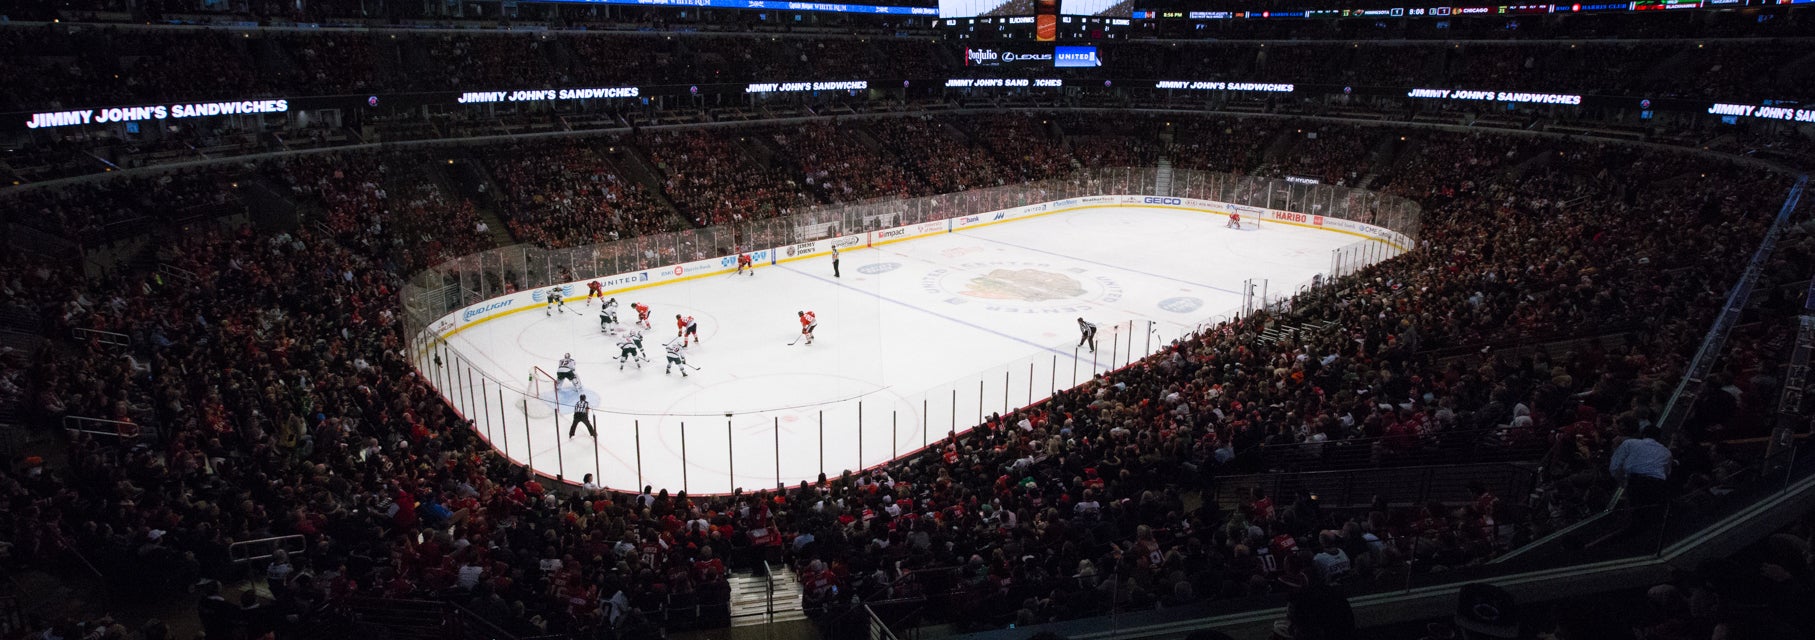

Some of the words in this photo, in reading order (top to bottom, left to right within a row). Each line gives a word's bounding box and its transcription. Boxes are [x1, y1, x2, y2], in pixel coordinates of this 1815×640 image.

[745, 83, 779, 93] JIMMY
[779, 82, 811, 92] JOHN'S
[812, 81, 867, 91] SANDWICHES
[945, 79, 973, 87] JIMMY
[974, 79, 1003, 87] JOHN'S
[1156, 80, 1189, 89] JIMMY
[1190, 81, 1225, 90] JOHN'S
[1226, 82, 1294, 92] SANDWICHES
[458, 91, 507, 103] JIMMY
[508, 90, 556, 101] JOHN'S
[559, 87, 639, 100] SANDWICHES
[1408, 88, 1450, 98] JIMMY
[1451, 90, 1495, 100] JOHN'S
[1497, 92, 1581, 105] SANDWICHES
[26, 110, 93, 129] JIMMY
[95, 105, 167, 123] JOHN'S
[171, 100, 288, 118] SANDWICHES
[1708, 103, 1755, 116] JIMMY
[1755, 106, 1794, 120] JOHN'S
[1144, 196, 1181, 205] GEICO
[966, 215, 979, 223] bank
[1275, 211, 1306, 223] HARIBO
[884, 227, 905, 238] impact
[1365, 226, 1377, 234] CME
[797, 242, 815, 250] JIMMY
[797, 248, 815, 256] JOHN'S
[601, 276, 638, 288] UNITED
[466, 307, 484, 318] BUD
[485, 299, 514, 312] LIGHT
